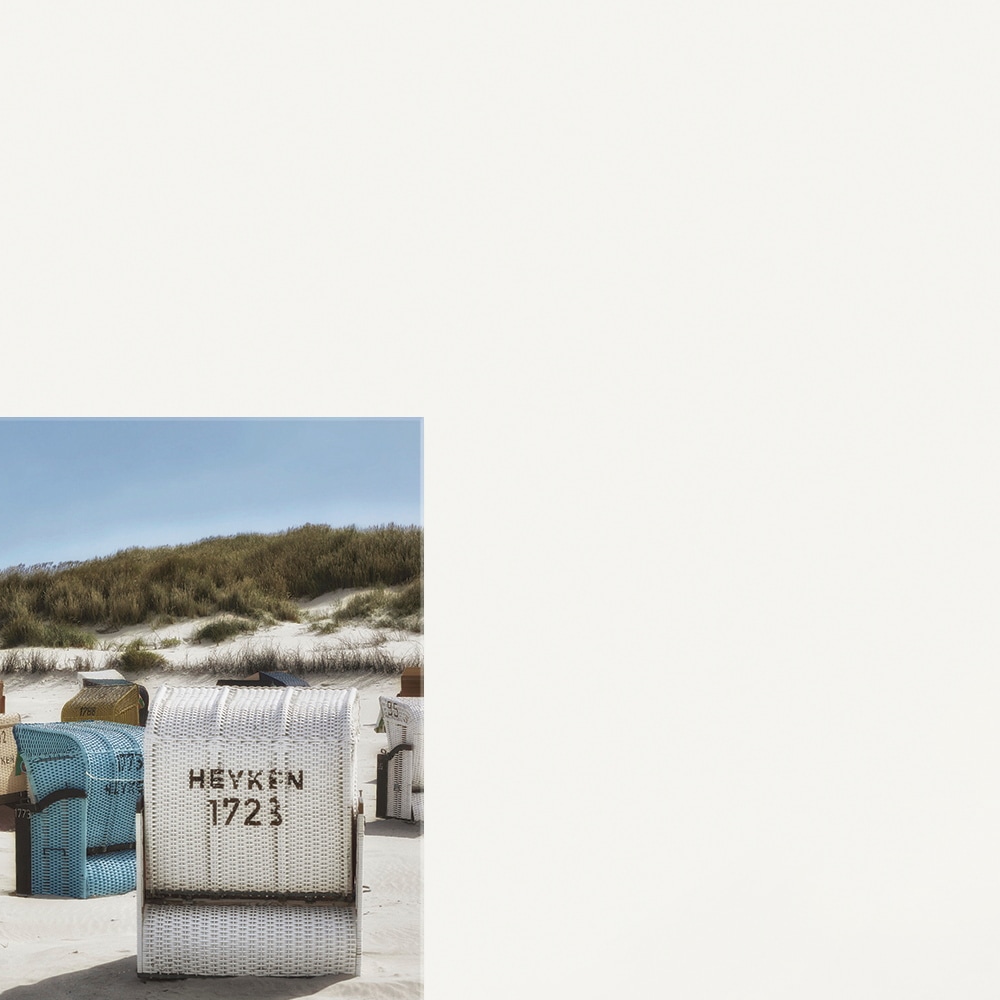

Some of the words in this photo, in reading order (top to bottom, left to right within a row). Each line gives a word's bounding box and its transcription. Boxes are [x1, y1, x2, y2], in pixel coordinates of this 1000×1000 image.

[189, 769, 304, 790] HEYKEN
[14, 808, 31, 818] 1773
[208, 798, 283, 826] 1723
